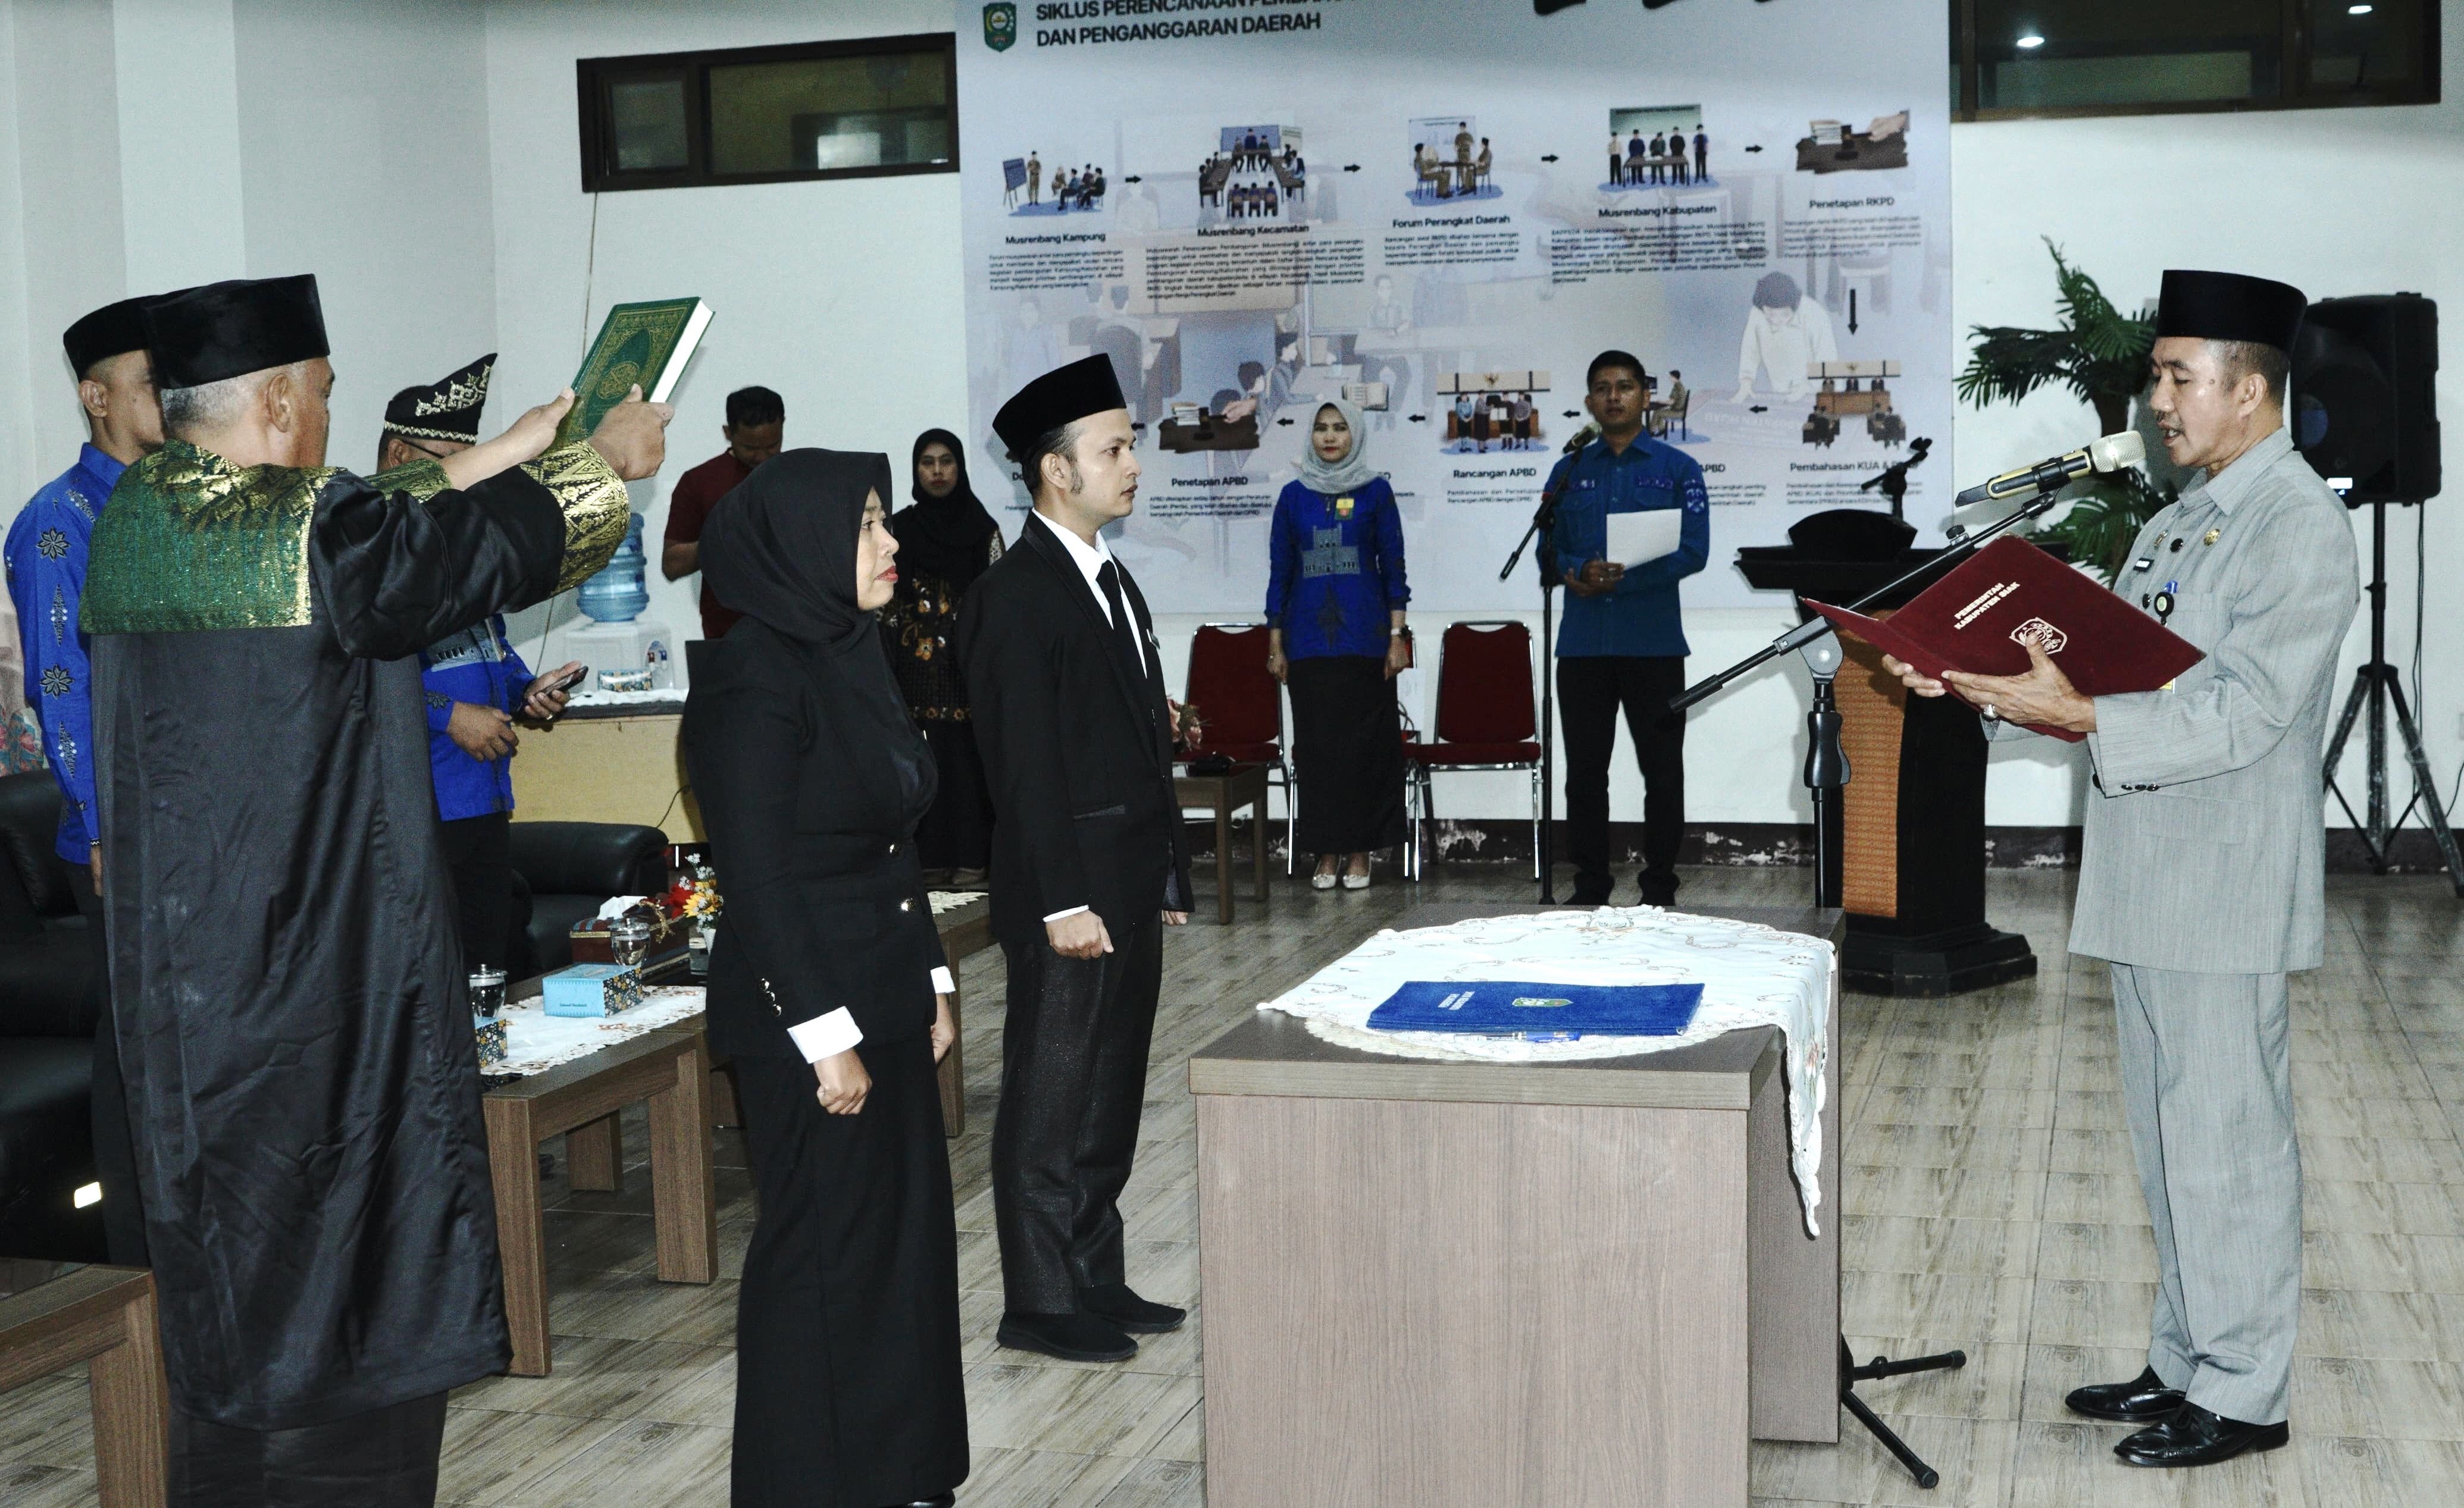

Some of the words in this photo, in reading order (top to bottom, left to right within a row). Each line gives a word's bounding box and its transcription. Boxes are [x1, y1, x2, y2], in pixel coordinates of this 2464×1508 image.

[1035, 1, 1100, 20] SIKLUS
[1037, 28, 1076, 46] DAN
[1079, 17, 1238, 43] PENGANGGARAN
[1241, 12, 1321, 33] DAERAH
[1809, 199, 1863, 209] Penetapan
[1866, 197, 1895, 206] RKPD
[1598, 207, 1660, 218] Musrenbang
[1663, 205, 1717, 215] Kabupaten
[1392, 218, 1423, 228] Forum
[1425, 216, 1473, 227] Perangkat
[1476, 215, 1511, 225] Daerah
[1197, 226, 1256, 237] Musrenbang
[1257, 224, 1310, 234] Kecamatan
[1006, 236, 1062, 244] Musrenbang
[1063, 233, 1106, 243] Kampung
[1453, 469, 1507, 479] Rancangan
[1509, 467, 1536, 476] APBD
[1790, 462, 1855, 472] Pembahasan
[1857, 461, 1880, 470] KUA
[1172, 477, 1220, 487] Penetapan
[1222, 476, 1248, 485] APBD
[1953, 595, 2000, 629] KABUPATEN
[1999, 582, 2020, 597] SIAK
[1954, 582, 2005, 619] PEMERINTAH
